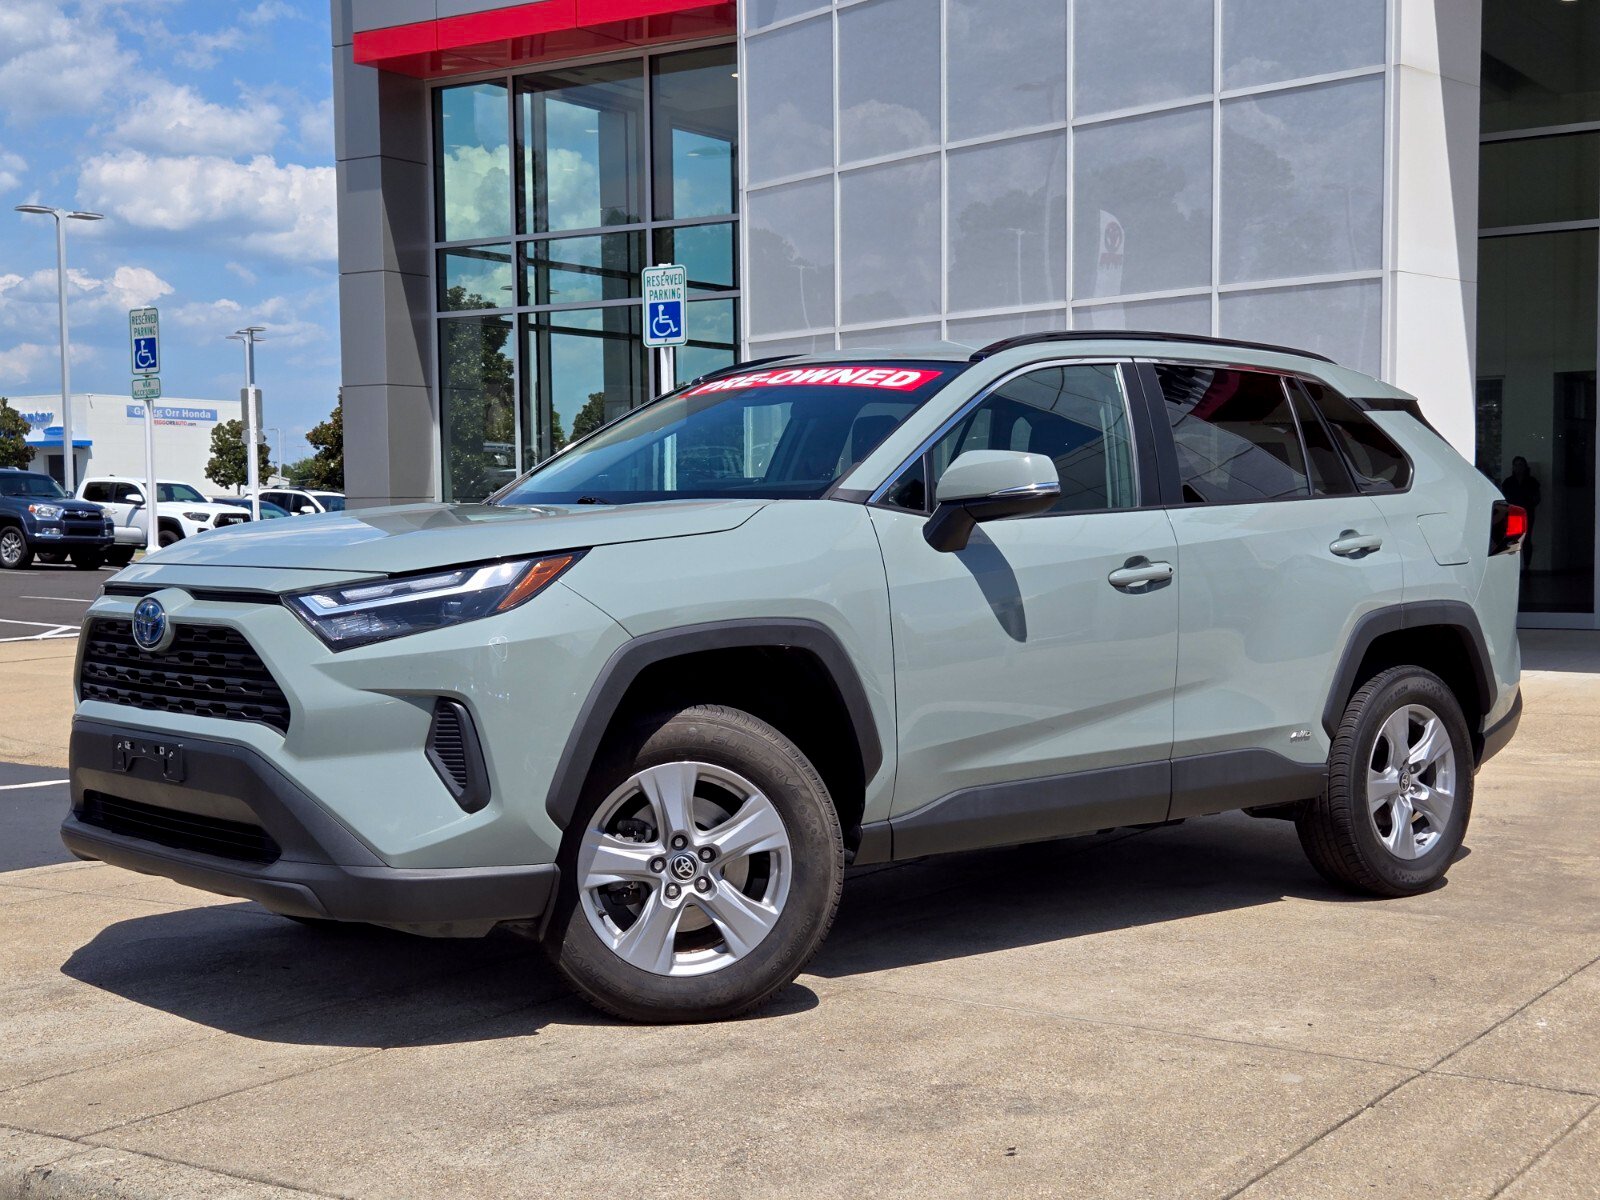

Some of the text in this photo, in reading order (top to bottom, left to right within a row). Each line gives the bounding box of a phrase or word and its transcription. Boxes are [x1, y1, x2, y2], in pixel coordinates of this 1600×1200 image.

[646, 273, 683, 287] RESERVED
[649, 287, 681, 301] PARKING
[131, 314, 156, 325] RESERVED
[134, 326, 156, 337] PARKING
[687, 368, 921, 396] PRE-OWNED
[133, 406, 211, 419] Grgg Orr Honda
